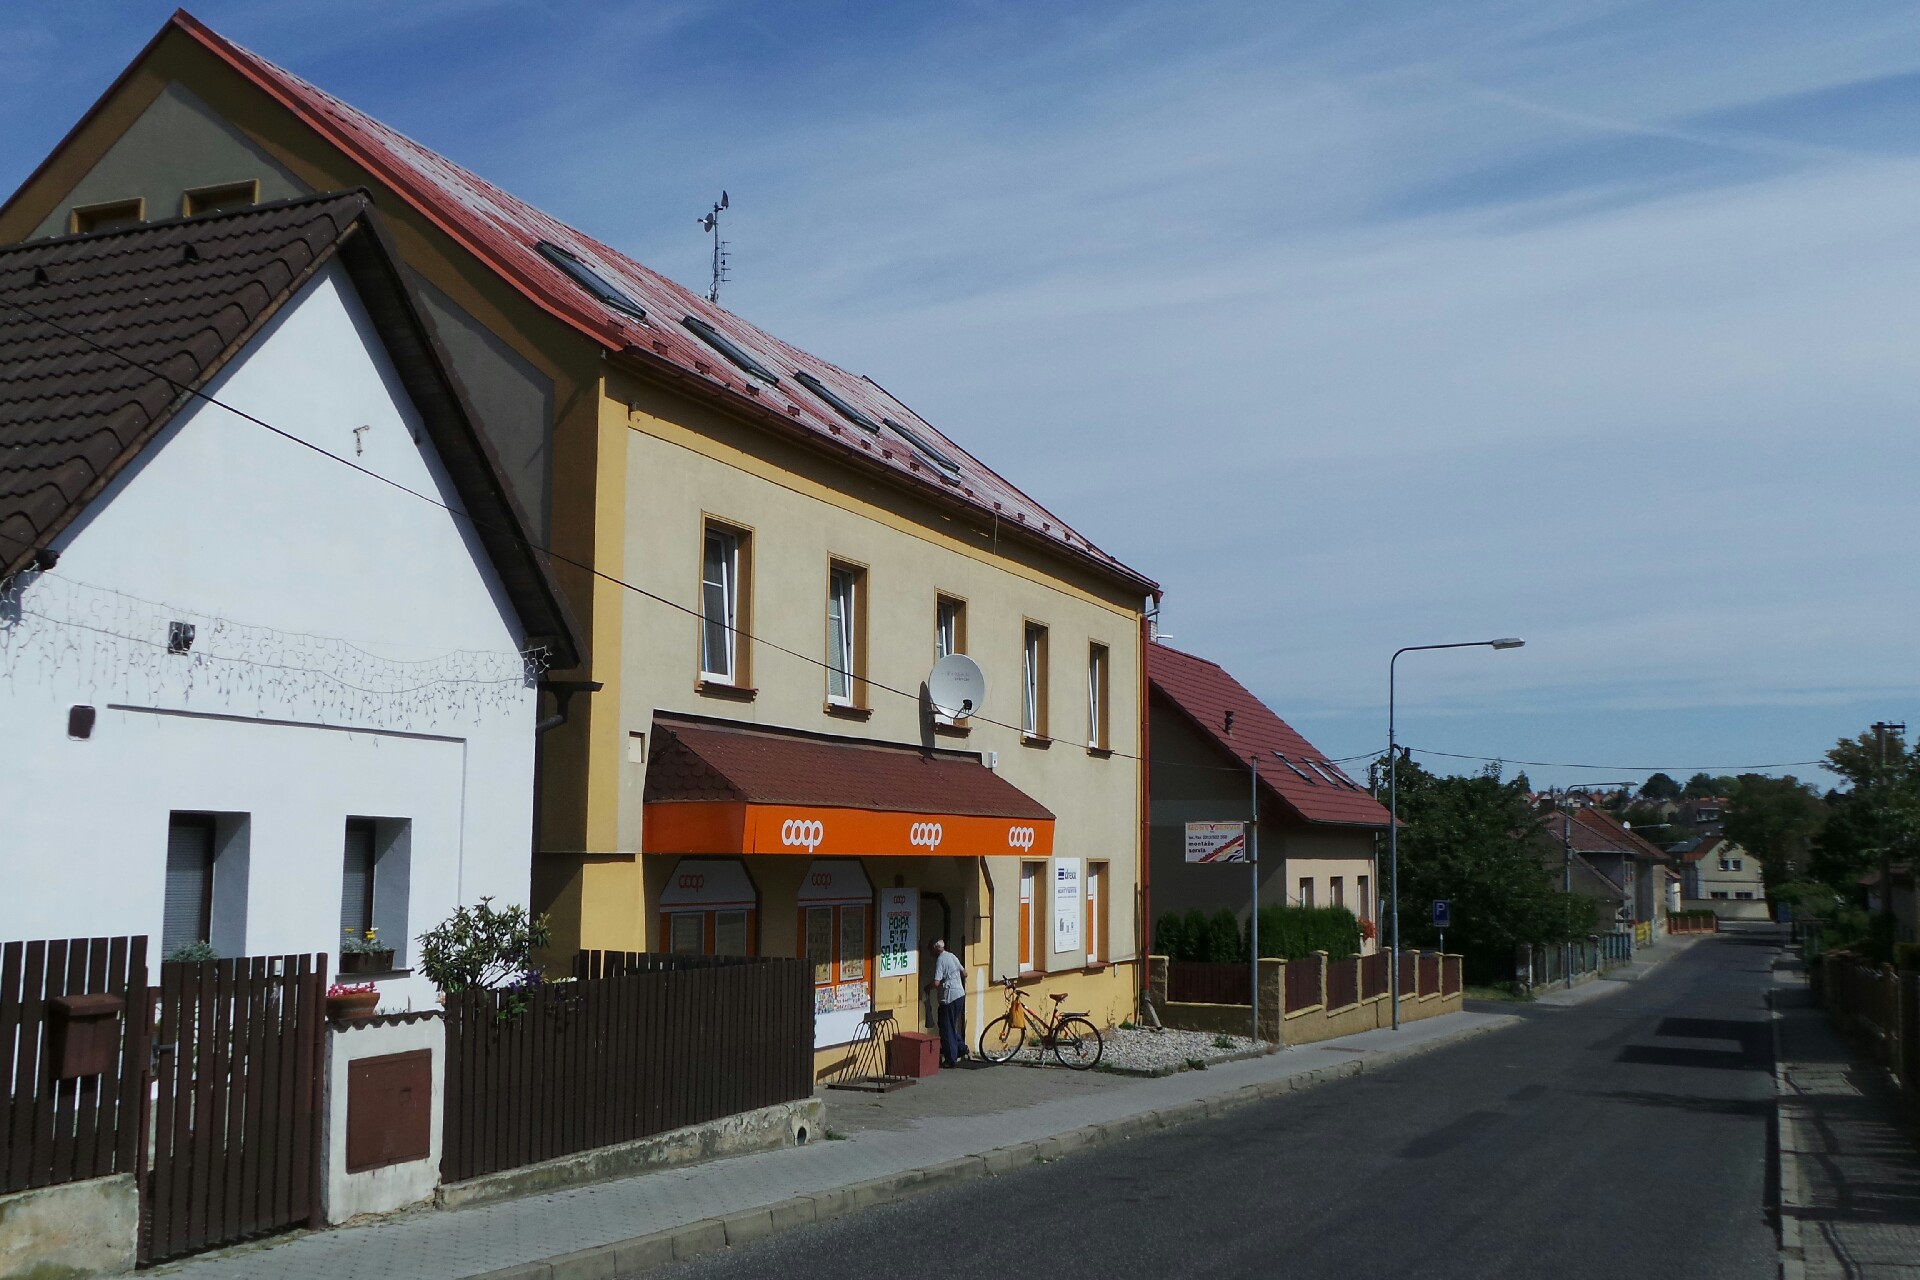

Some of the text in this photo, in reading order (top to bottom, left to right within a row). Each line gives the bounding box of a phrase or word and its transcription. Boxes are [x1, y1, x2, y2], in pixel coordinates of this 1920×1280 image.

[781, 819, 824, 853] coop
[910, 822, 943, 852] coop
[1008, 826, 1035, 852] coop
[679, 874, 704, 893] coop
[811, 872, 832, 890] coop
[1436, 902, 1446, 916] P
[881, 958, 890, 971] NE
